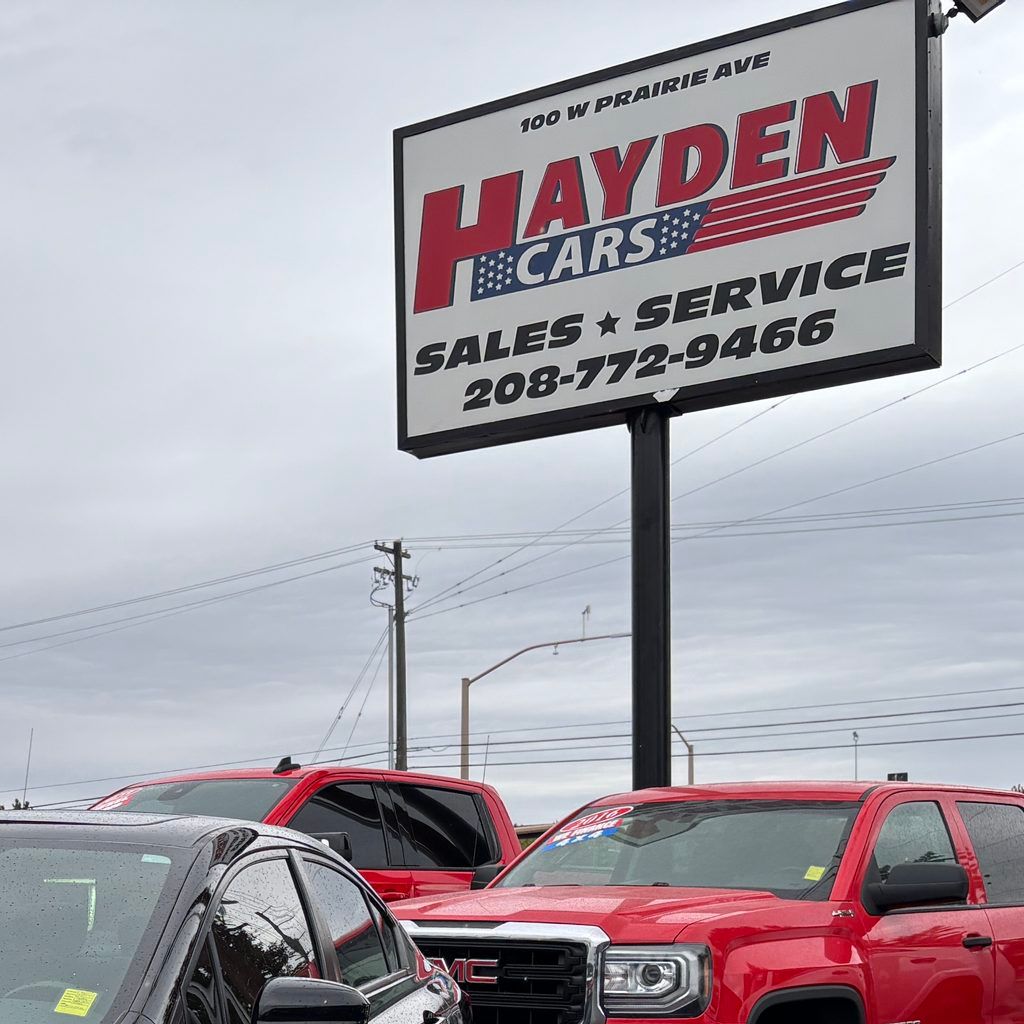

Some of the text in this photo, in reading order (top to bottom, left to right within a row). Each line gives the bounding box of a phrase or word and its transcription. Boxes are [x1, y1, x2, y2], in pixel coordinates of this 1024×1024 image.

[519, 51, 771, 134] 100 W PRAIRIE AVE
[414, 79, 879, 314] HAYDEN
[515, 219, 658, 285] CARS
[414, 242, 911, 376] SALES SERVICE
[463, 309, 837, 411] 208-772-9466
[425, 957, 498, 984] MC
